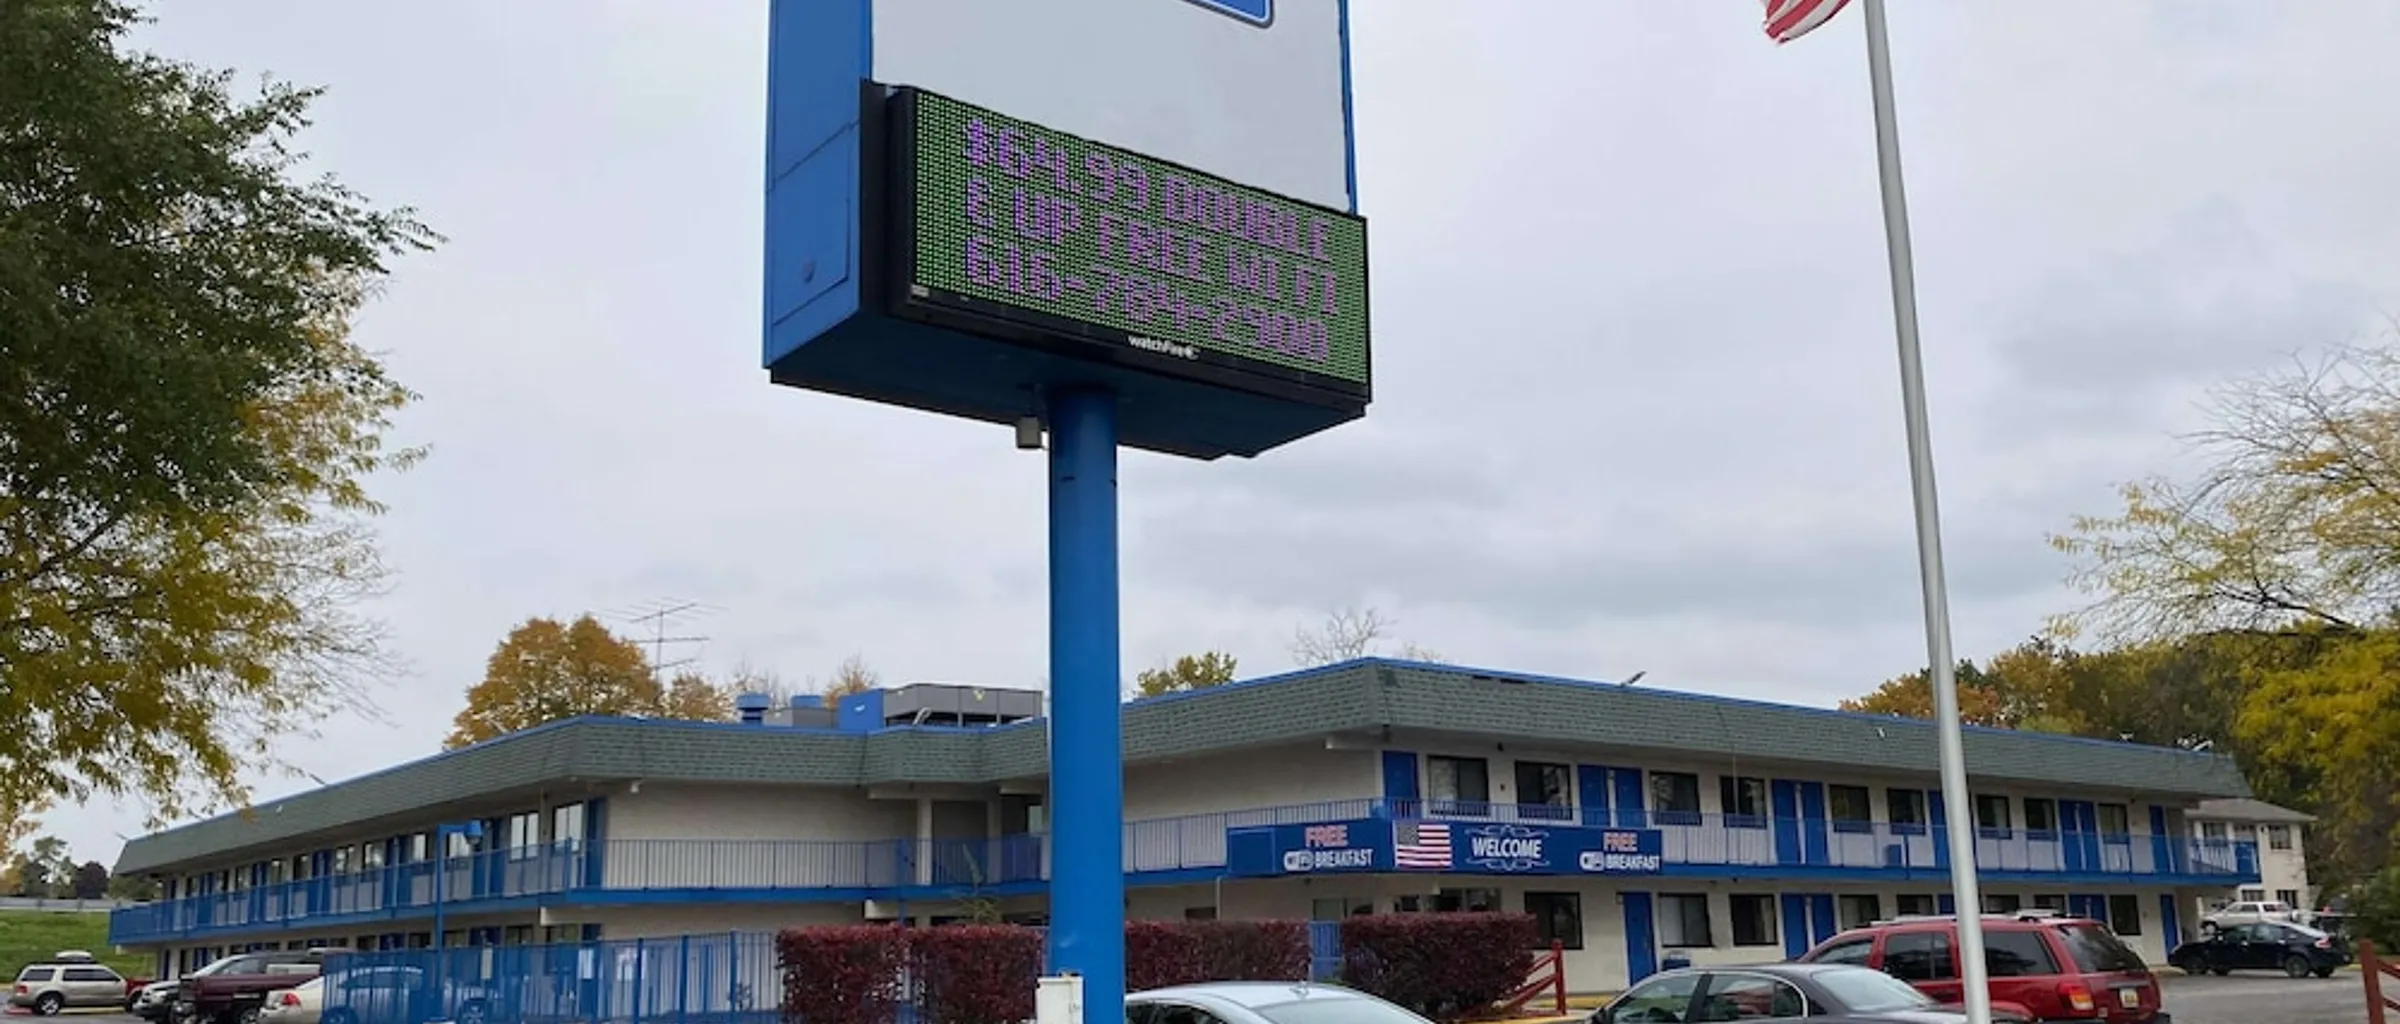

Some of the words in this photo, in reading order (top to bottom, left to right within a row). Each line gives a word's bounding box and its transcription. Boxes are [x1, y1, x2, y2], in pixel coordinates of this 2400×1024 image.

[1165, 175, 1332, 262] DOUBLE
[1013, 187, 1083, 246] UP
[1100, 213, 1212, 284] FREE
[1304, 825, 1348, 848] FREE
[1603, 831, 1638, 852] FREE
[1315, 848, 1374, 868] BREAKFAST
[1472, 837, 1543, 858] WELCOME
[1606, 853, 1660, 870] BREAKFAST
